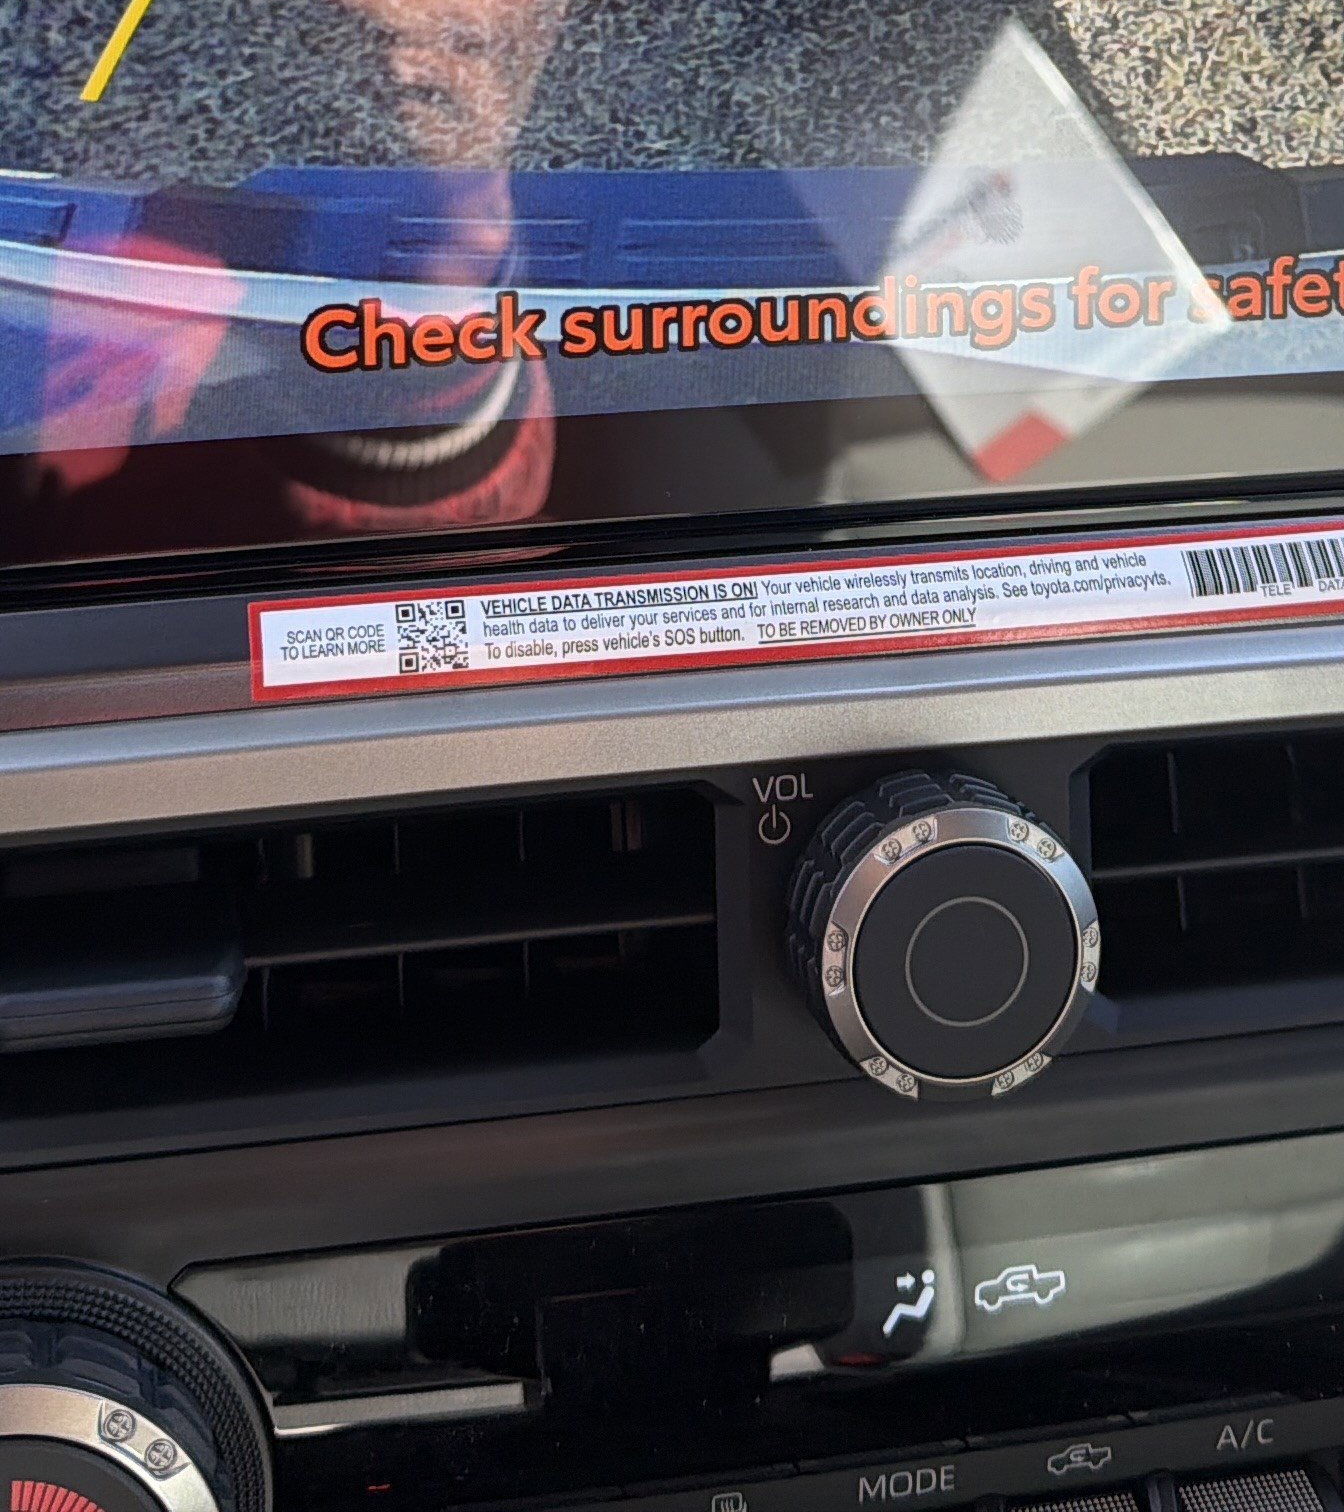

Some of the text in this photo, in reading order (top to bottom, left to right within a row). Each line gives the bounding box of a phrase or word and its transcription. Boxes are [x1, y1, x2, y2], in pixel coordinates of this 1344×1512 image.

[303, 293, 546, 370] Check
[560, 274, 1055, 350] surroundings
[1069, 265, 1175, 329] for
[480, 595, 548, 616] VEHICLE
[552, 592, 591, 613] DATA
[594, 585, 709, 608] TRANSMISSION
[713, 582, 727, 599] IS
[761, 579, 793, 596] Your
[795, 574, 841, 593] vehicle
[843, 570, 907, 590] wirelessly
[911, 565, 969, 585] transmits
[972, 563, 1027, 581] location,
[1029, 558, 1072, 576] driving
[1075, 555, 1099, 572] and
[1101, 552, 1147, 569] vehicle
[1260, 584, 1292, 598] TELE
[483, 571, 1172, 638] health data to deliver your services and for internal research and data analysis. See toyota.com/privacyvts.
[281, 639, 386, 661] TO LEARN MORE
[287, 624, 385, 644] SCAN QR CODE
[484, 607, 977, 660] To disable, press vehicle's SOS button. TO BE REMOVED BY OWNER ONLY
[752, 773, 813, 804] VOL
[1217, 1417, 1274, 1451] A/C
[859, 1464, 956, 1505] MODE
